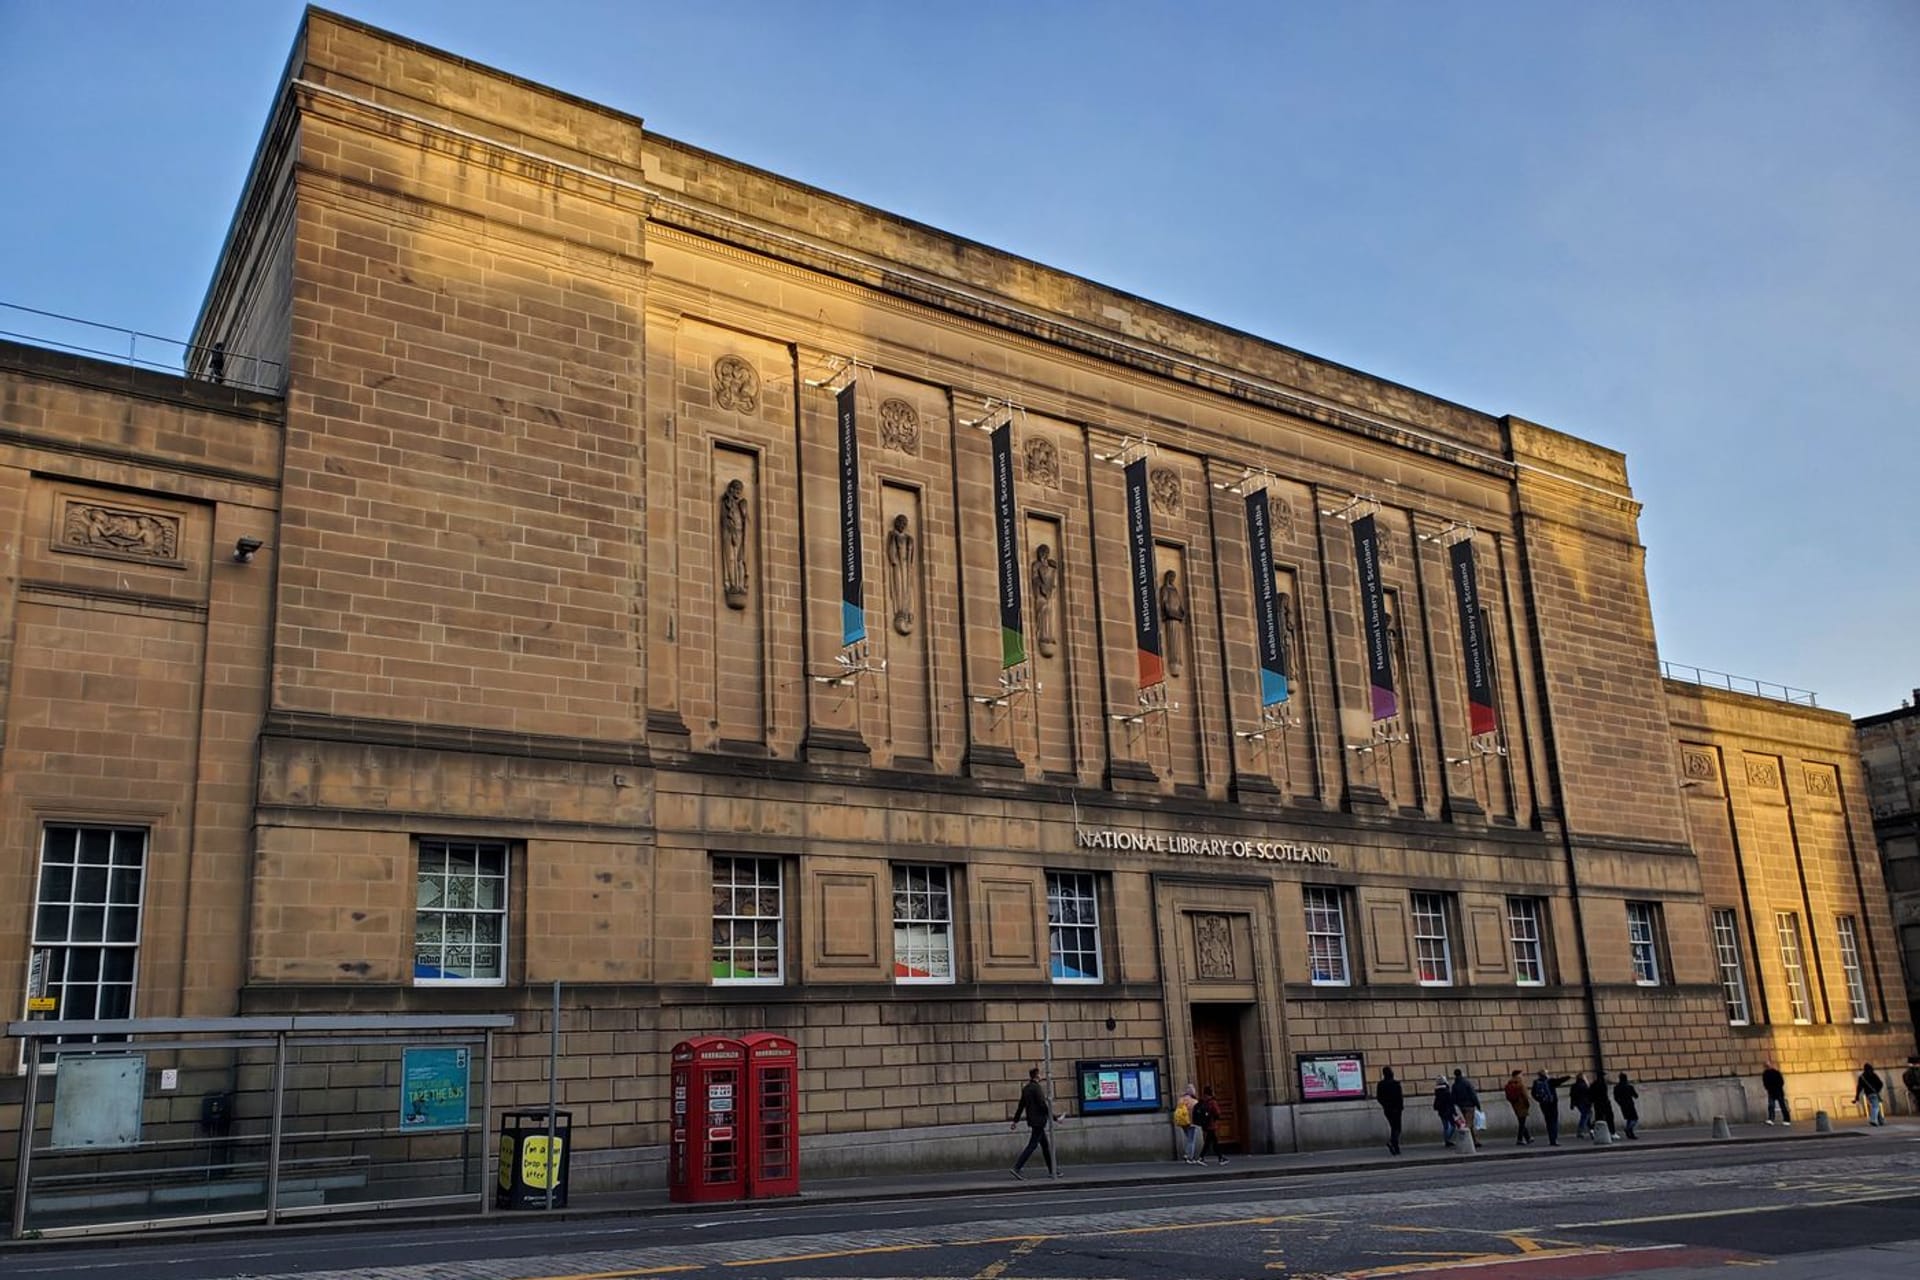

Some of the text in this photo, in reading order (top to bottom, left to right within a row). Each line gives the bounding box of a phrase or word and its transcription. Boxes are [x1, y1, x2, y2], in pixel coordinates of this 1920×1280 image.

[843, 413, 852, 465] Scotland
[998, 453, 1014, 607] National Library of Scotland
[1133, 486, 1151, 631] National Library of Scotland
[1259, 538, 1266, 550] na
[1266, 600, 1277, 661] Leabharlann
[1362, 539, 1384, 670] National Library of Scotland
[1460, 562, 1482, 687] National Library of Scotland
[1078, 829, 1331, 863] NATIONAL LIBRARY OF SCOTLAND
